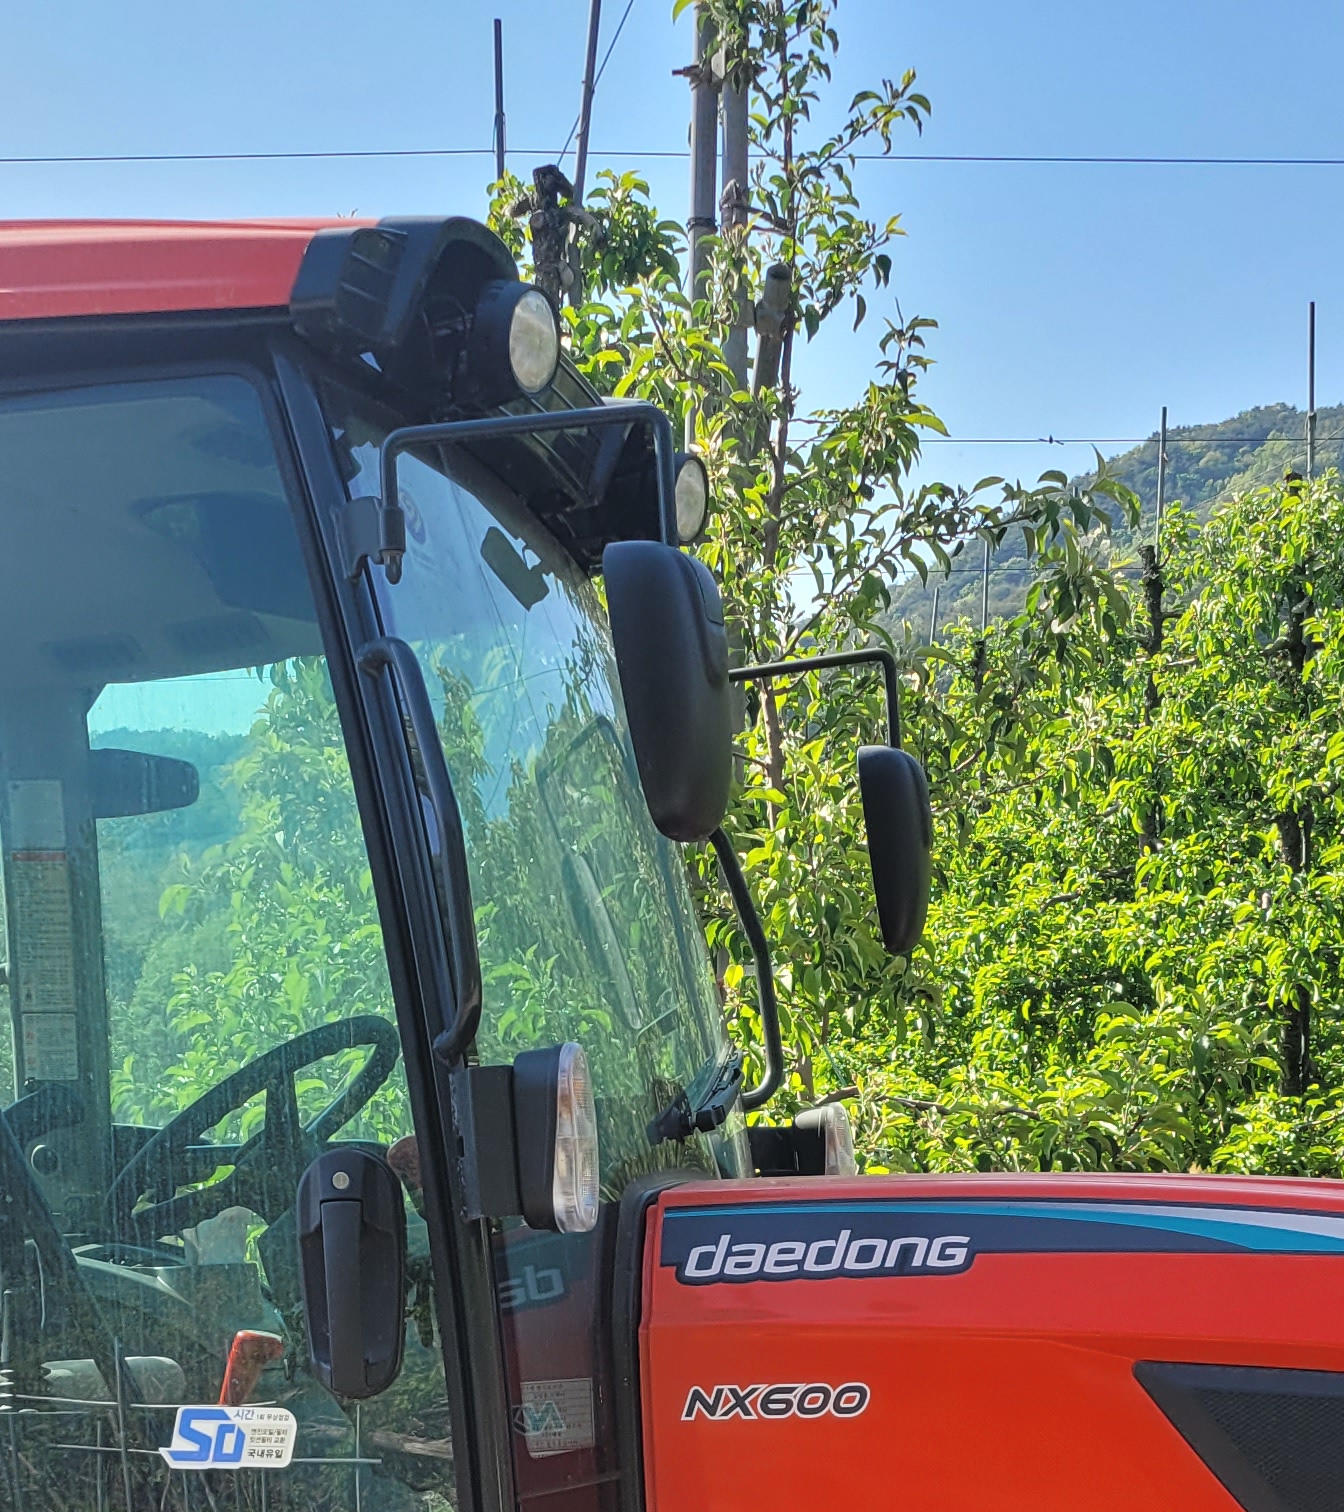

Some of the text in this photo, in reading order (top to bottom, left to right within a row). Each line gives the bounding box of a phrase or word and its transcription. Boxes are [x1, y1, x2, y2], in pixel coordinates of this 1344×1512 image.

[684, 1228, 971, 1277] daedong
[680, 1382, 870, 1421] NX600
[234, 1409, 255, 1420] 시간
[247, 1448, 283, 1459] 국내유일
